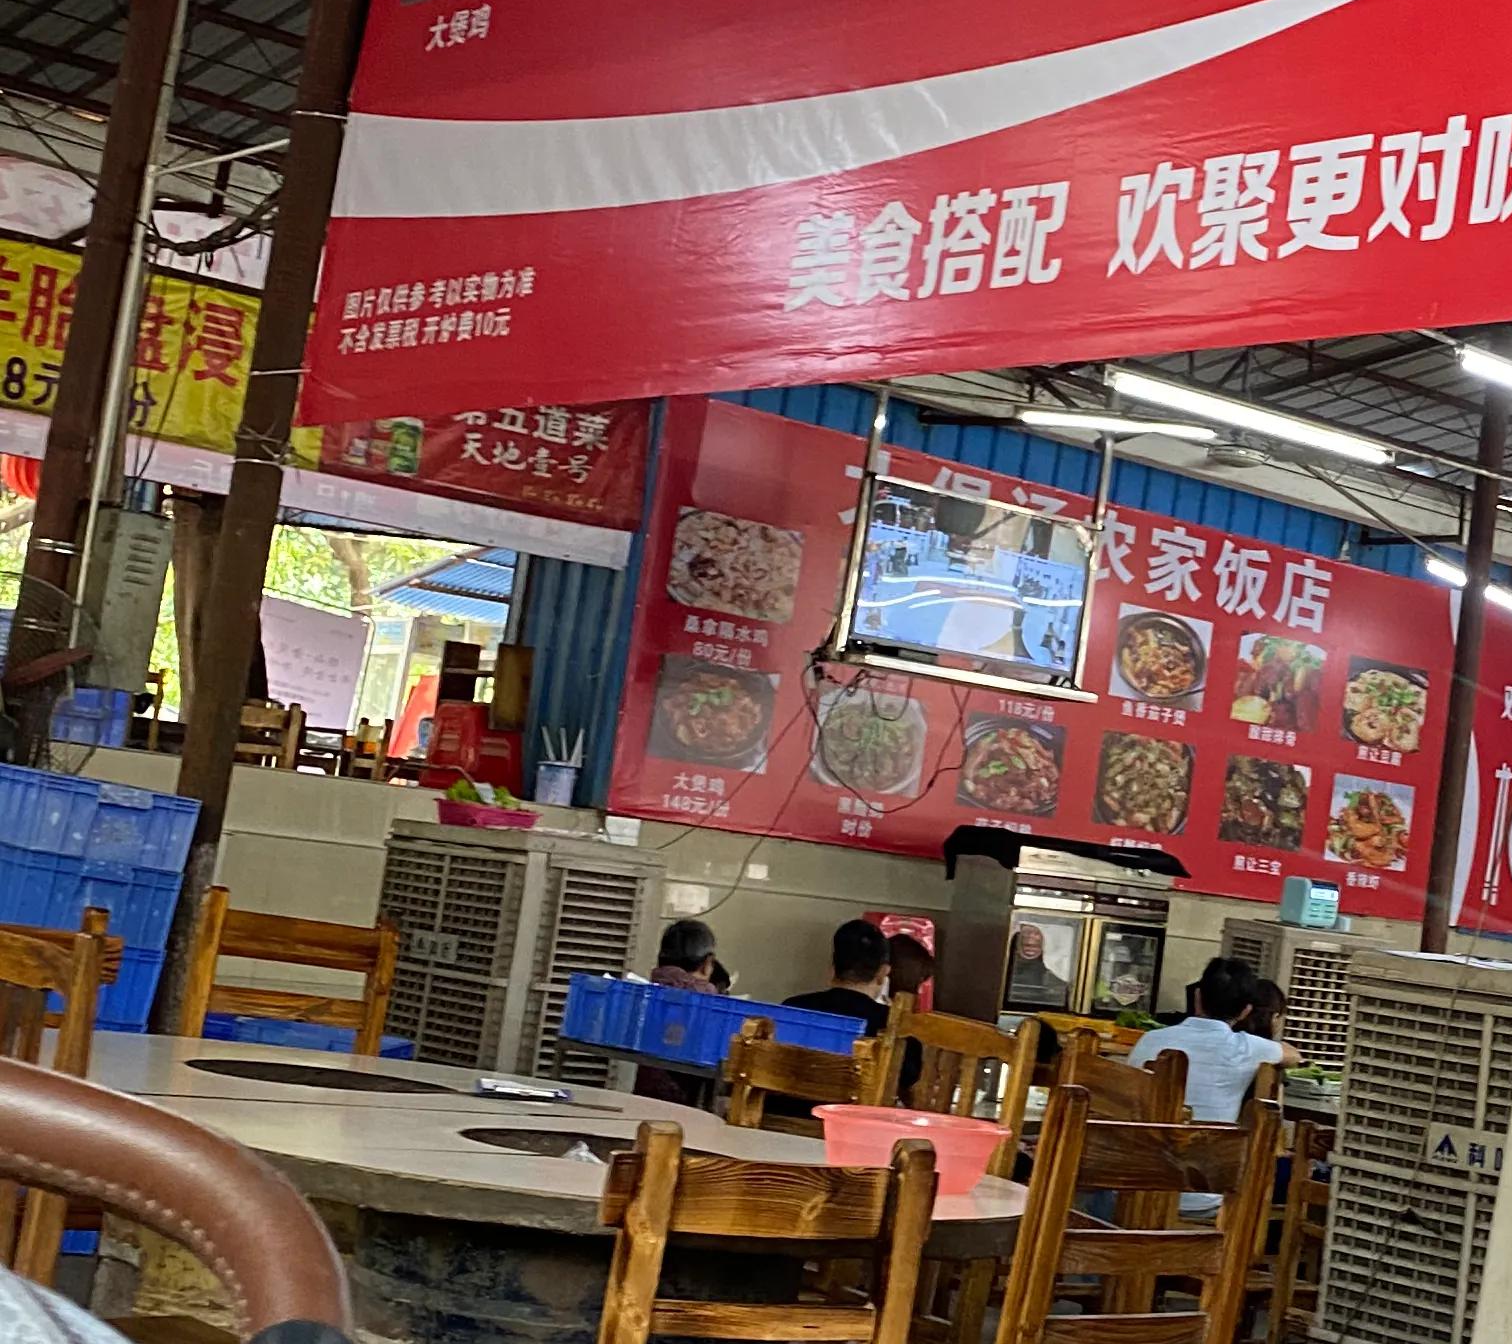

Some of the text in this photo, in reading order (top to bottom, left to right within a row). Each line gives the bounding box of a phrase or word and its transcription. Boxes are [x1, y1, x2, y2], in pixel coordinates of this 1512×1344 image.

[425, 3, 492, 52] 大煲鸡
[785, 178, 1070, 310] 美食搭配
[460, 432, 593, 484] 天地壹号
